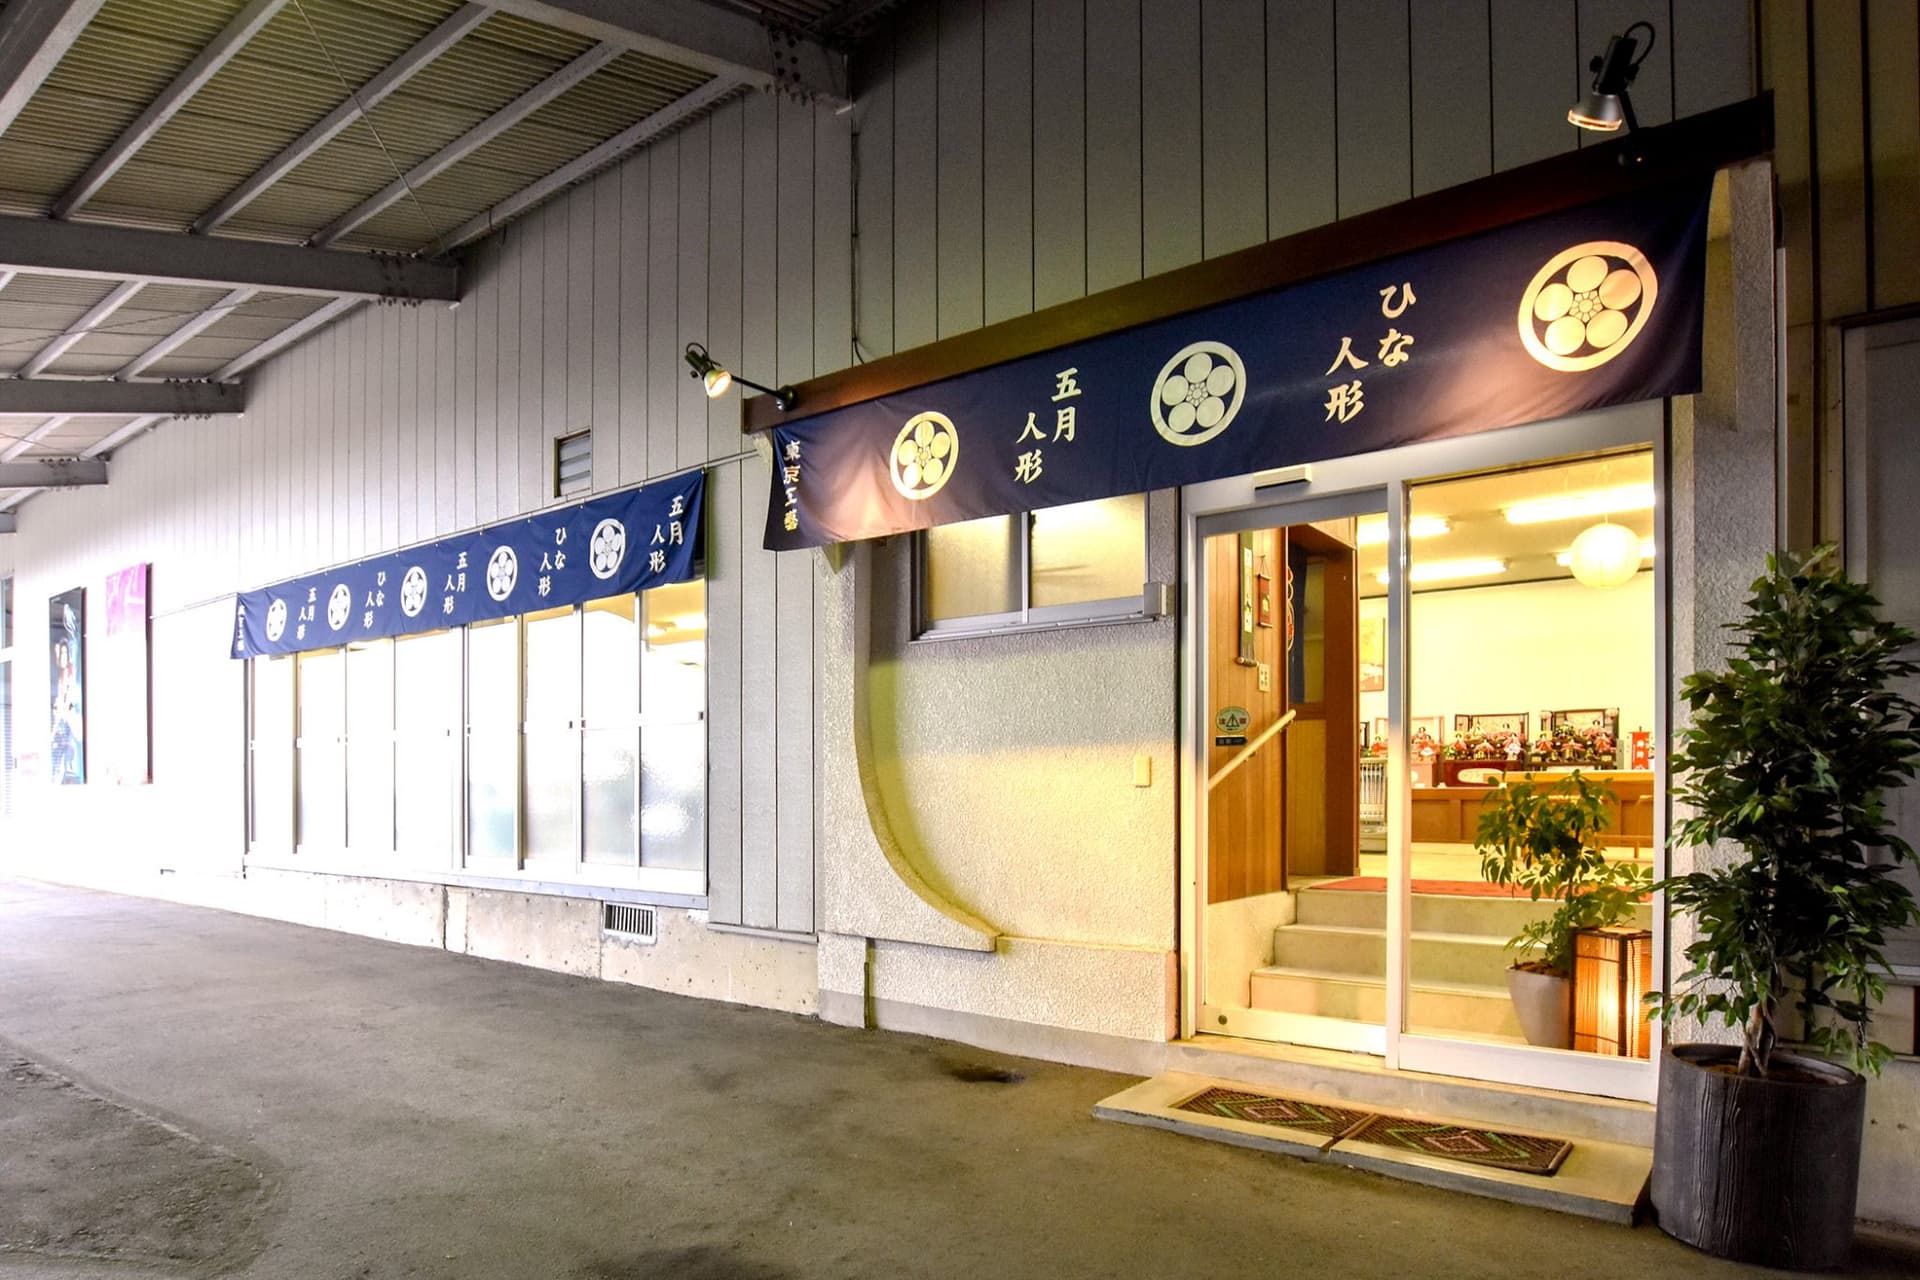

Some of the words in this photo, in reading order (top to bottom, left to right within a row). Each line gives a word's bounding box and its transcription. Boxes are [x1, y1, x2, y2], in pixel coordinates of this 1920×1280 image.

[1378, 282, 1417, 367] ひな
[1324, 336, 1370, 423] 人形
[1051, 367, 1082, 443] 五月
[1014, 411, 1047, 484] 人形
[668, 495, 685, 545] 五月
[456, 551, 468, 592] 五月
[555, 527, 567, 570] ひな
[649, 524, 666, 573] 人形
[443, 574, 455, 615] 人形
[538, 552, 552, 597] 人形
